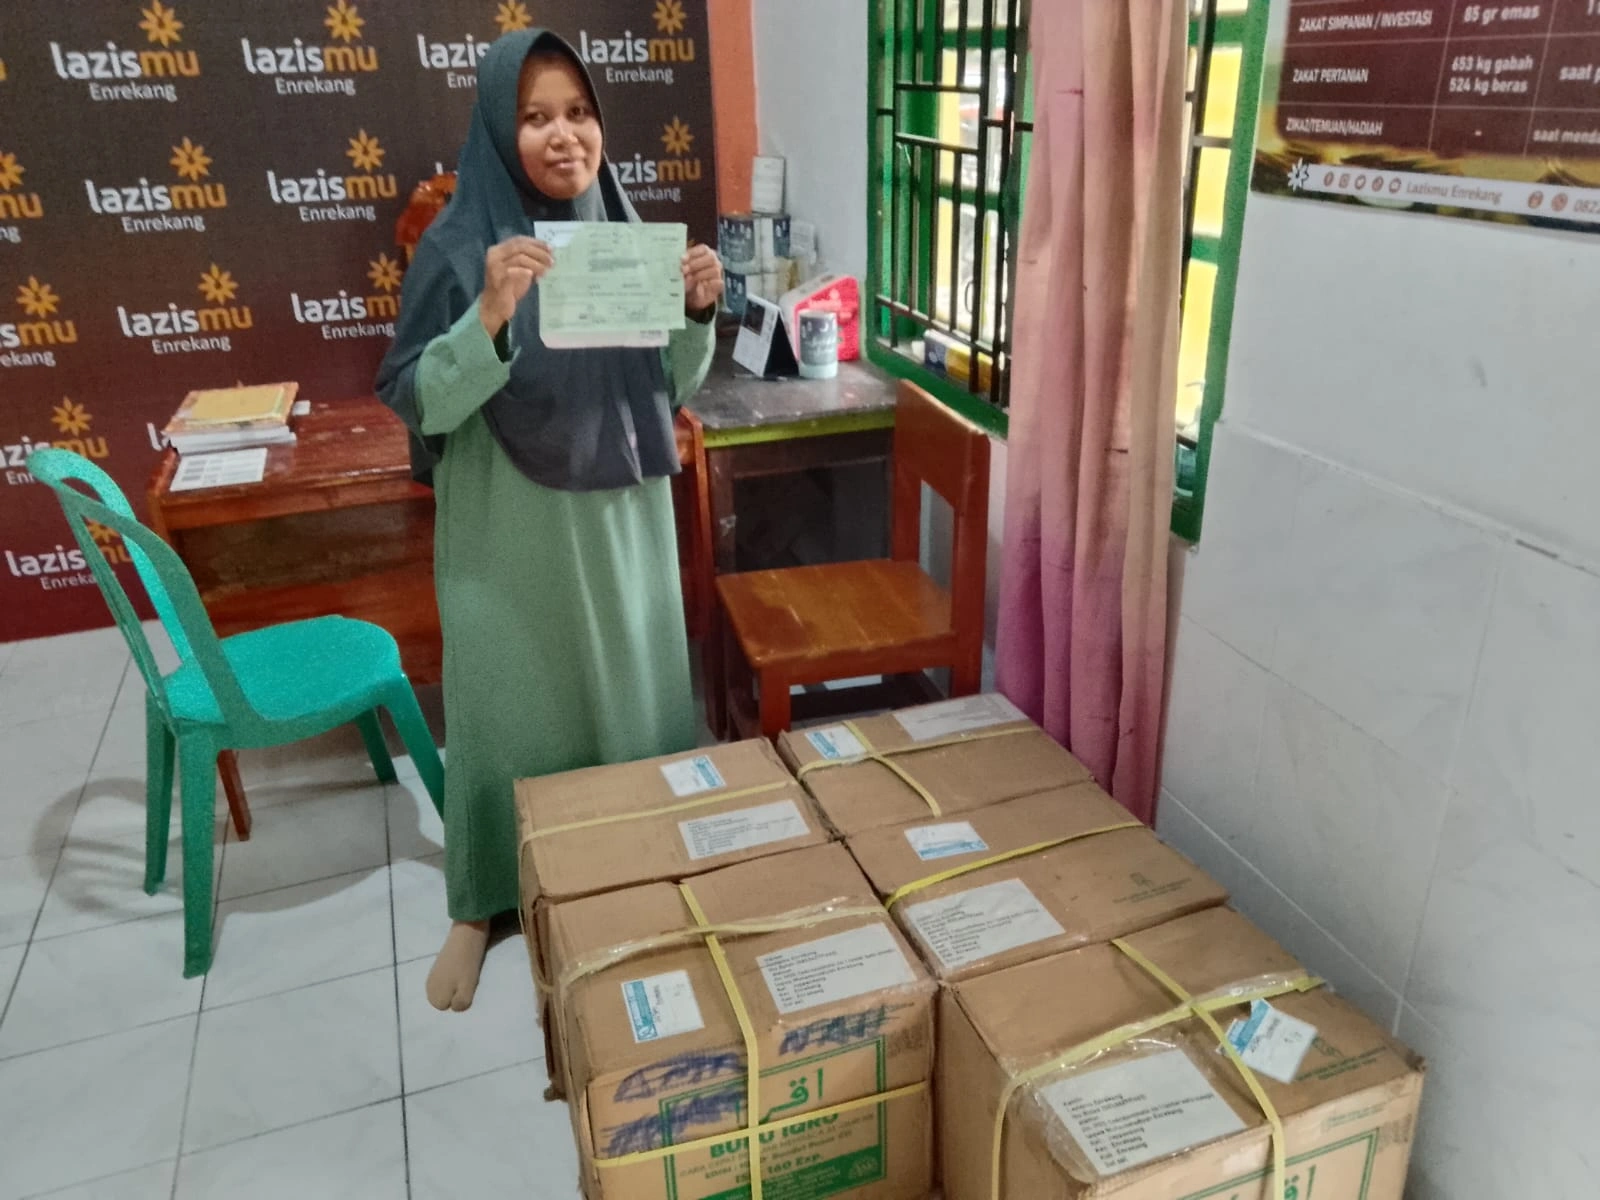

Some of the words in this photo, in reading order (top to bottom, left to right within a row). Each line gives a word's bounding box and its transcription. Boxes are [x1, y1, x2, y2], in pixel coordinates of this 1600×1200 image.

[1299, 17, 1327, 32] ZAKAT
[1381, 10, 1433, 28] INVESTASI
[1482, 7, 1498, 25] gr
[1501, 5, 1540, 21] emas
[241, 38, 379, 74] lazismu
[580, 30, 695, 63] lazismu
[50, 42, 200, 79] lazismu
[1476, 56, 1492, 74] kg
[1494, 54, 1534, 74] gabah
[606, 67, 674, 85] Enrekang
[1293, 69, 1319, 82] ZAKAT
[1320, 68, 1369, 82] PERTANIAN
[89, 83, 177, 102] Enrekang
[275, 78, 356, 96] Enrekang
[1474, 78, 1489, 96] kg
[1491, 78, 1528, 93] beras
[267, 169, 397, 203] lazismu
[626, 186, 681, 202] nrekang
[85, 178, 227, 214] lazismu
[299, 204, 376, 222] Enrekang
[122, 215, 205, 232] Enrekang
[291, 290, 400, 323] lazism
[117, 302, 253, 337] lazismu
[321, 322, 396, 340] Enrekang
[152, 335, 232, 354] Enrekang
